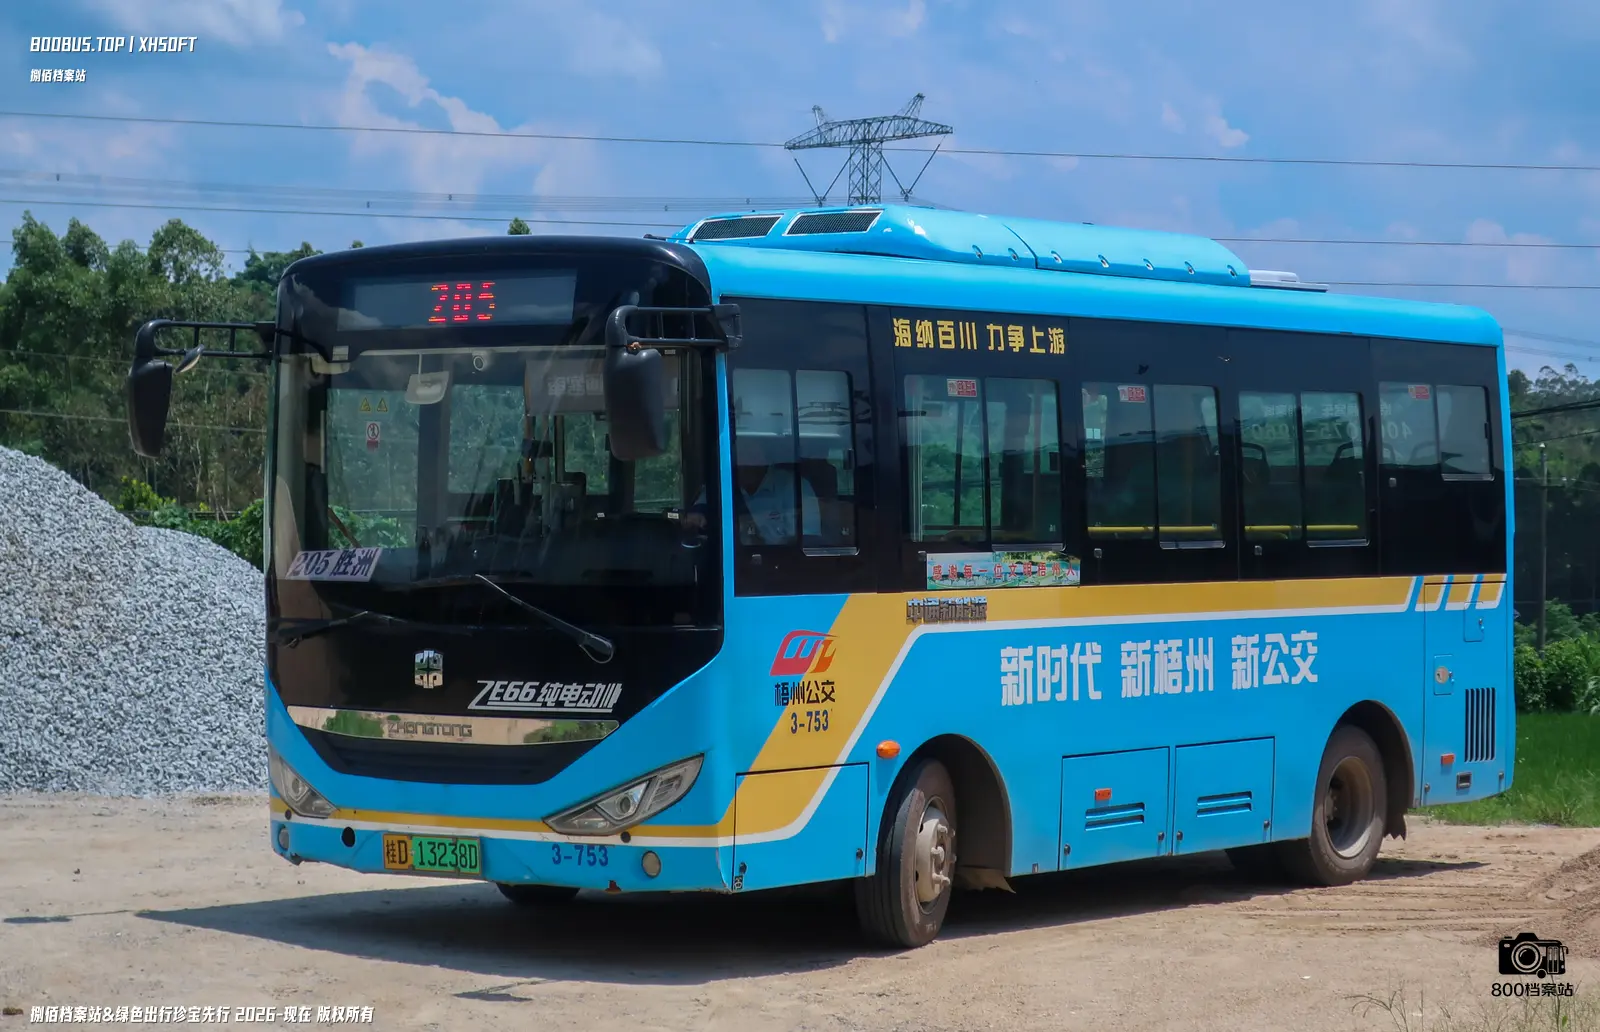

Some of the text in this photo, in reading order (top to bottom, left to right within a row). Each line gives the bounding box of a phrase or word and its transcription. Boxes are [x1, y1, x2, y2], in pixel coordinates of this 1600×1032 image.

[428, 282, 496, 322] 205
[892, 317, 1066, 355] 海纳百川 力争上游
[291, 551, 335, 577] 205
[932, 562, 1076, 581] 感谢每一位文明梧州人
[906, 596, 988, 624] 中通新能源
[1000, 630, 1318, 706] 新时代 新梧州 新公交
[774, 680, 836, 707] 梧州公交
[388, 719, 473, 738] ZHONGTONG
[790, 709, 829, 735] 3-753
[385, 839, 478, 870] 桂D 13238D
[551, 843, 609, 867] 3-753
